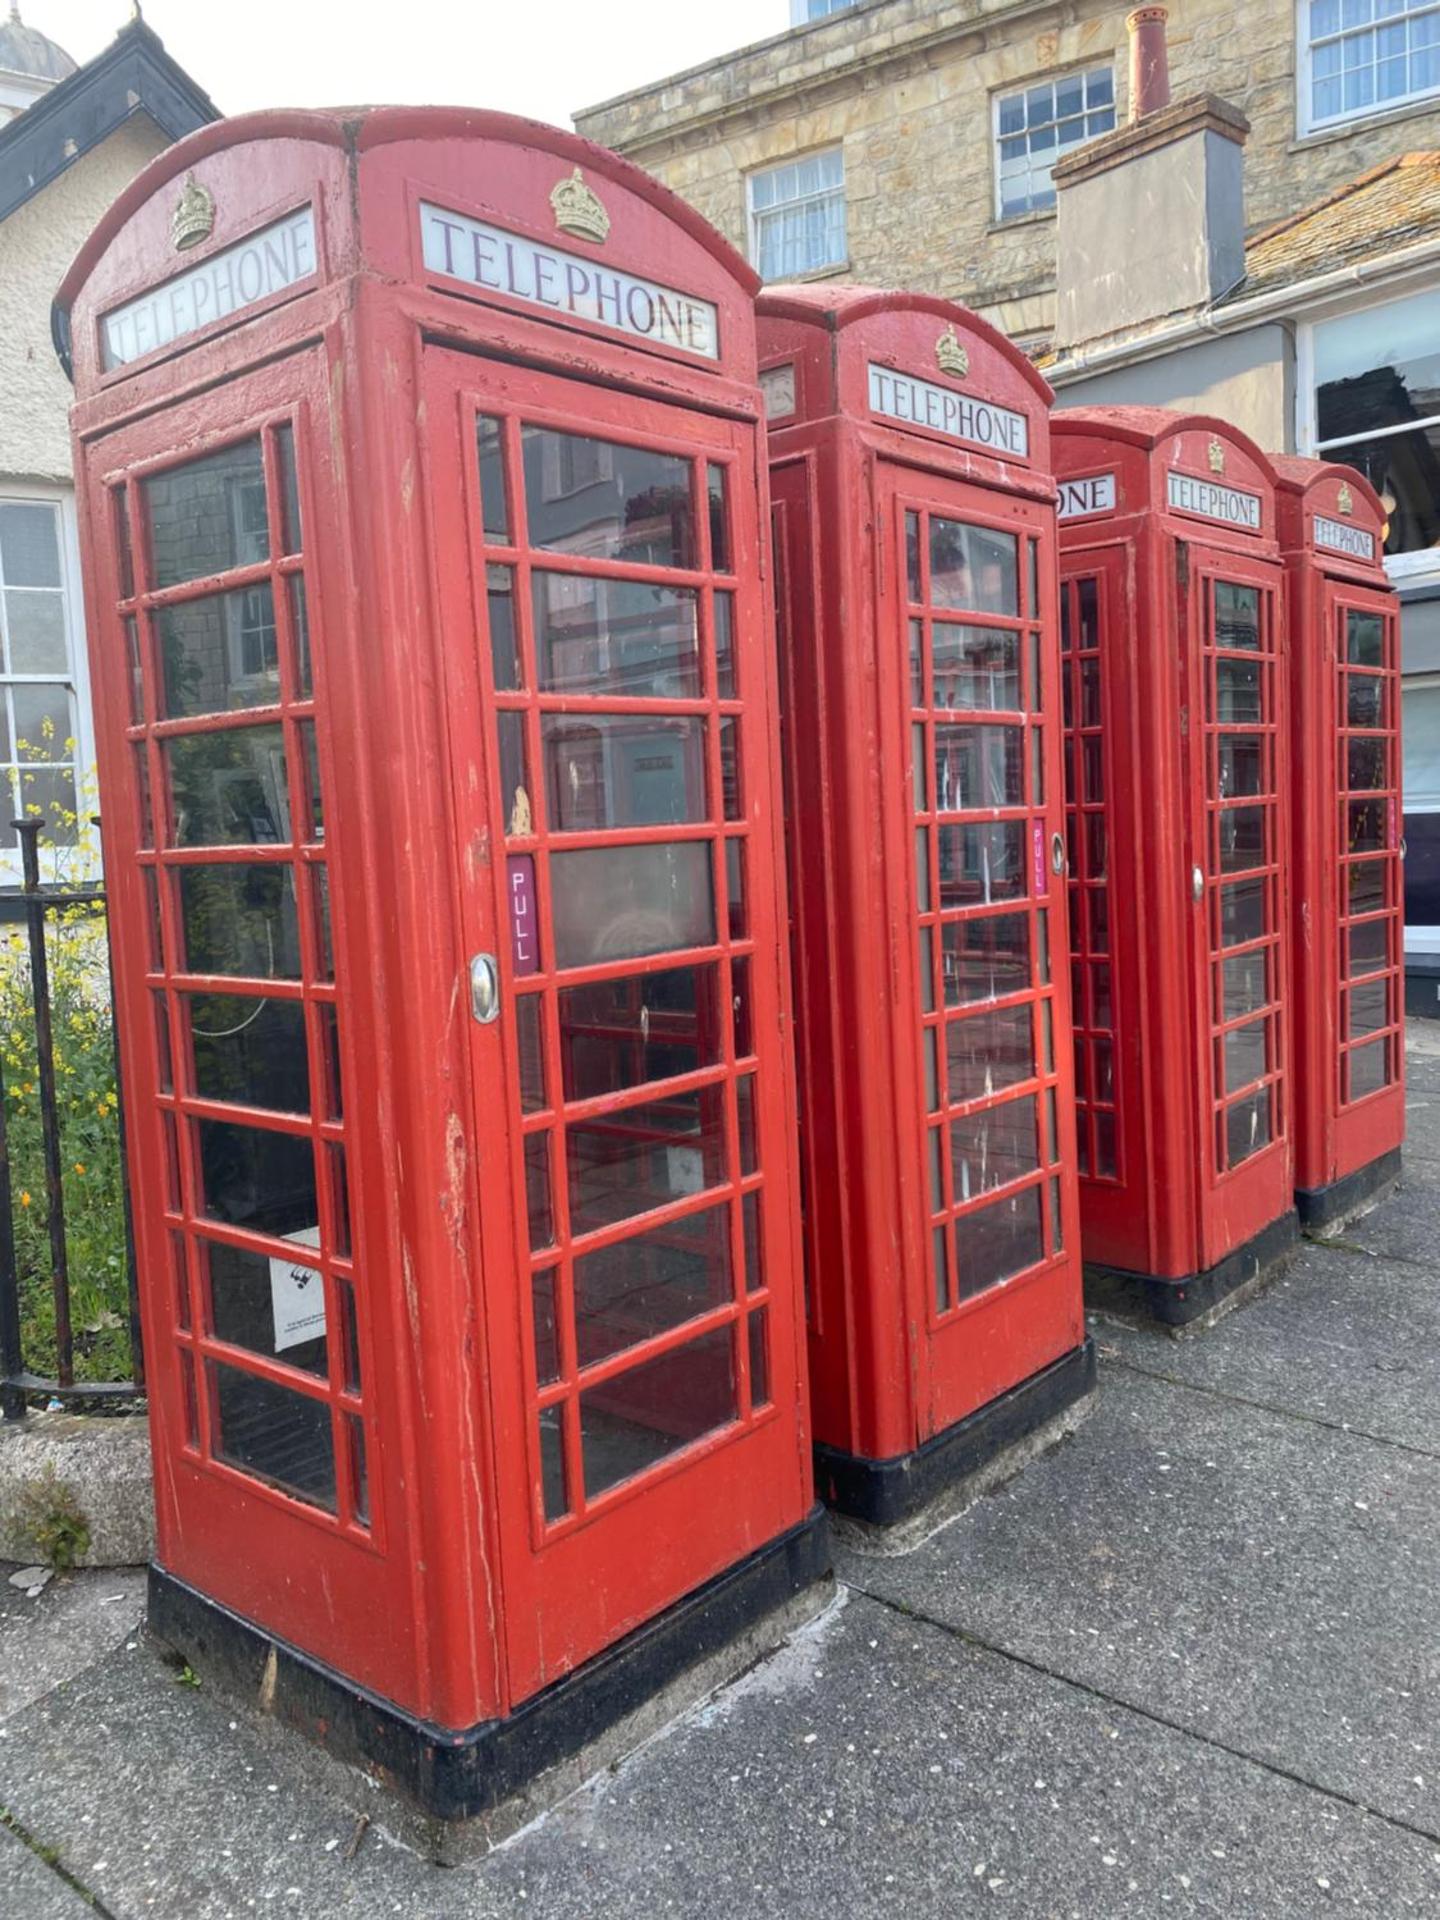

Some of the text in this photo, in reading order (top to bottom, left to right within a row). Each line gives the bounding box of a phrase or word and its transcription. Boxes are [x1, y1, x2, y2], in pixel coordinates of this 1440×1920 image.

[110, 219, 313, 363] TELEPHONE
[431, 217, 708, 351] TELEPHONE
[872, 372, 1022, 453] TELEPHONE
[1168, 476, 1256, 526] TELEPHONE
[1315, 518, 1371, 558] TELEPHONE
[512, 872, 530, 961] PULL
